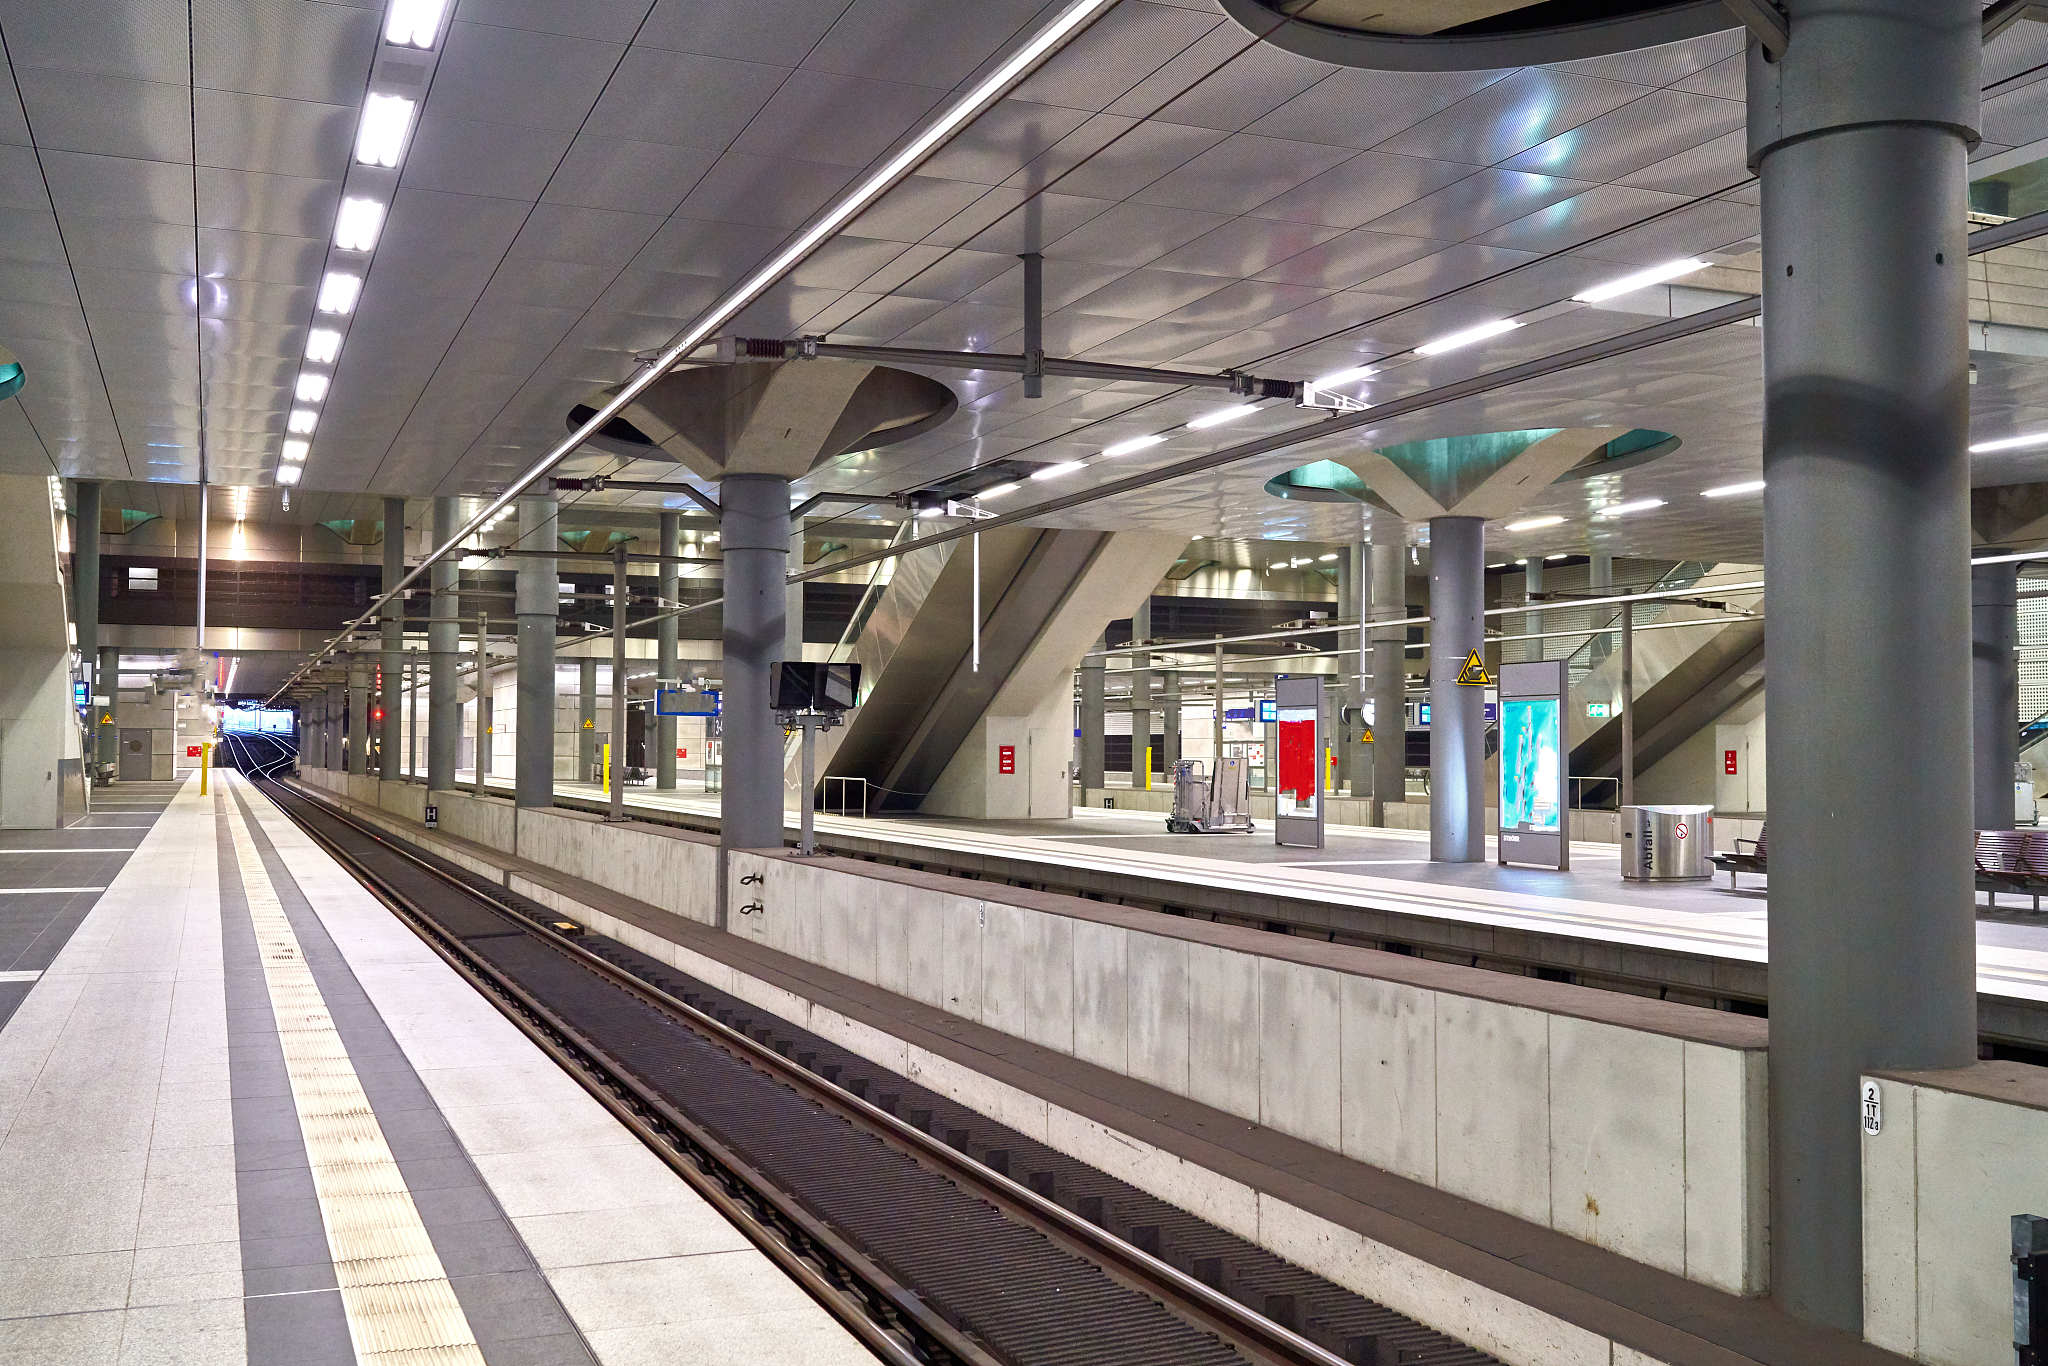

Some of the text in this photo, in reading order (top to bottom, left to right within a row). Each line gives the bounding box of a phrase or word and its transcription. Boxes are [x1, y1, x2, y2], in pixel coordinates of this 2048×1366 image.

[1105, 799, 1113, 809] H
[426, 808, 437, 820] H
[1643, 830, 1653, 870] Abfall
[1868, 1087, 1875, 1100] 2
[1866, 1103, 1877, 1118] 1T
